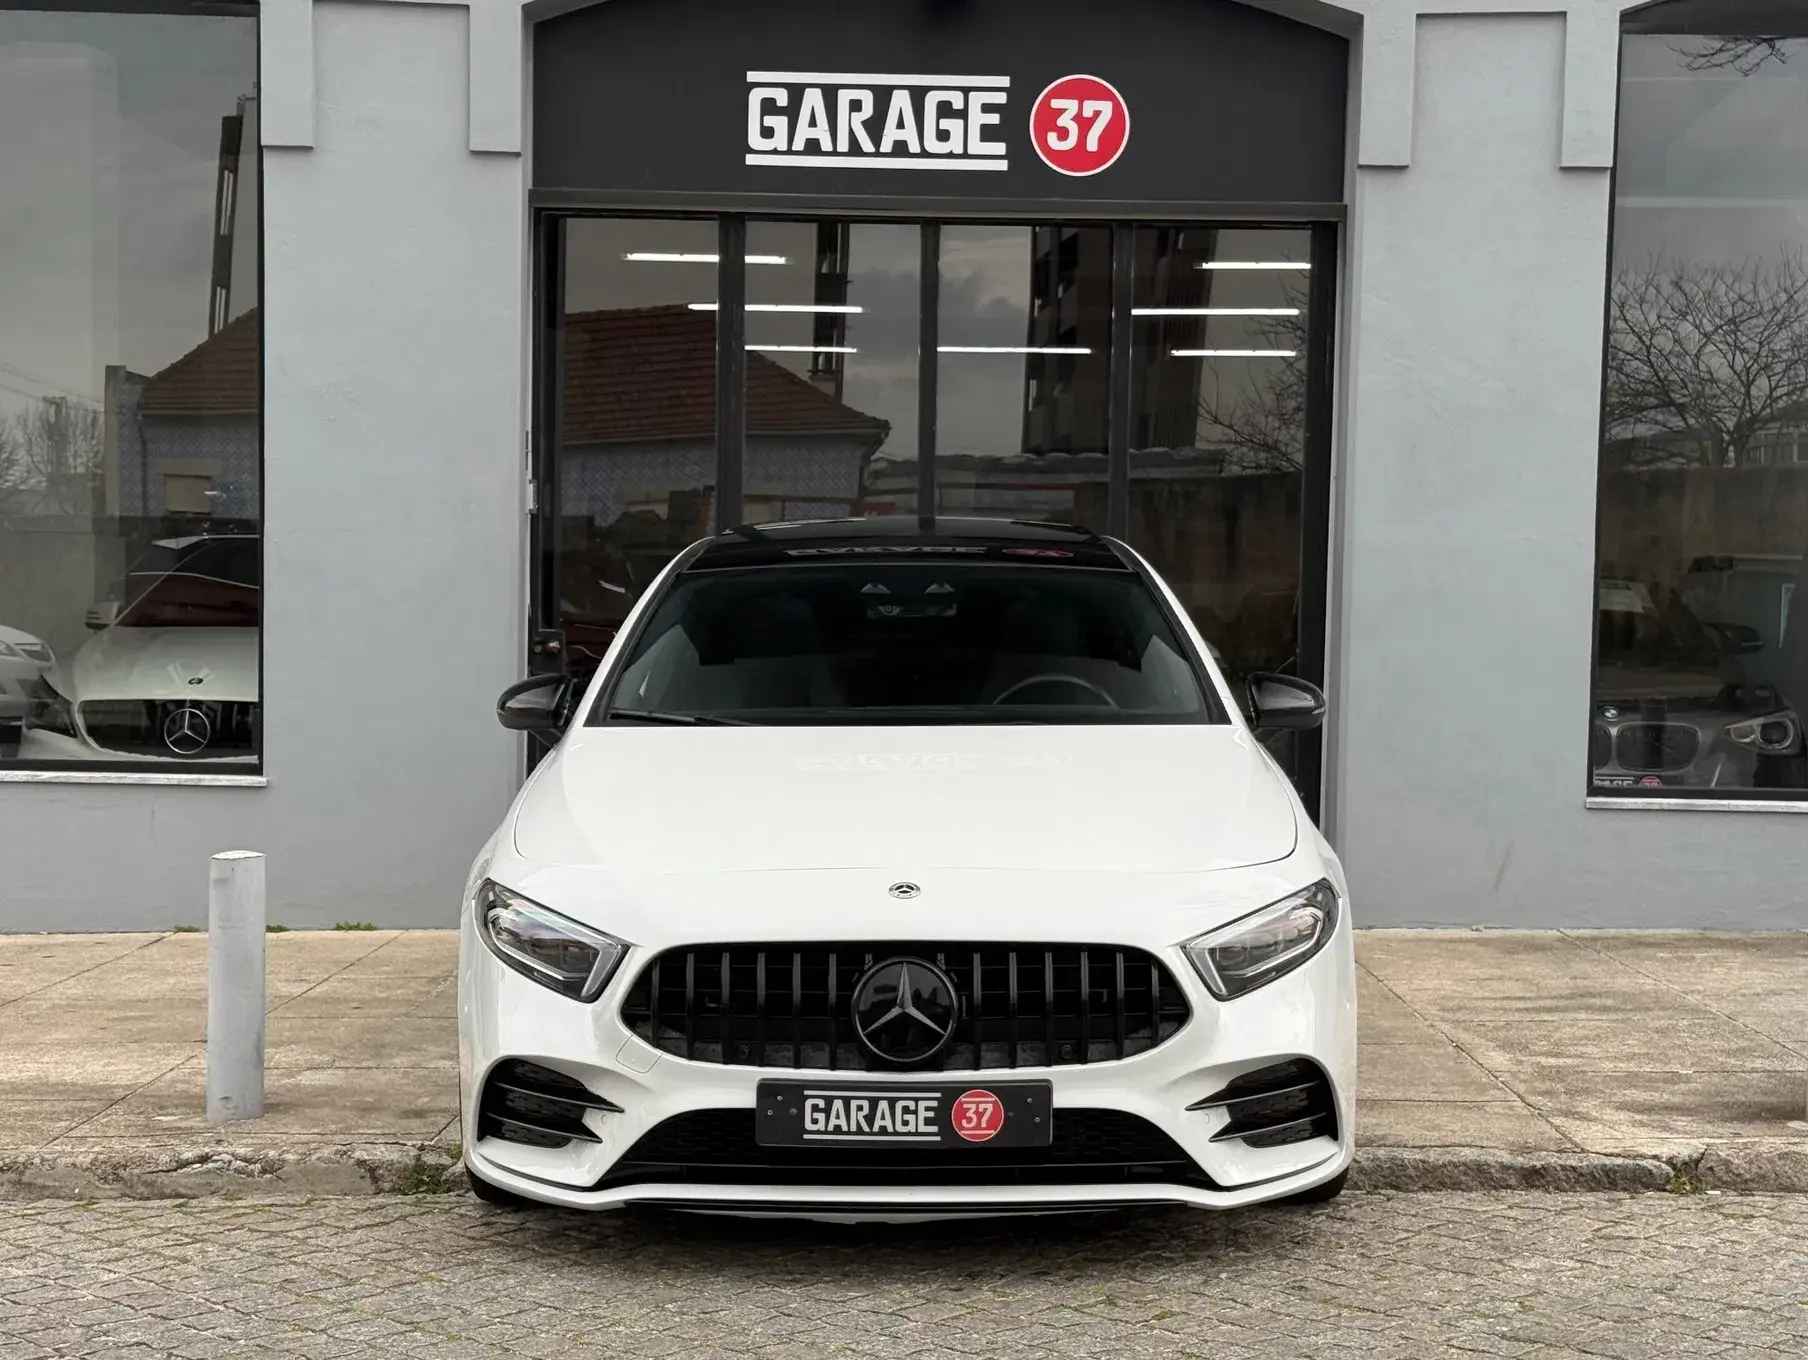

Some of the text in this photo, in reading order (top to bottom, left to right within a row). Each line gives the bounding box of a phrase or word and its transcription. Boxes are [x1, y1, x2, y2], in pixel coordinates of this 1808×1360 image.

[748, 87, 1113, 155] GARAGE 37
[804, 1098, 993, 1132] GARAGE 37
